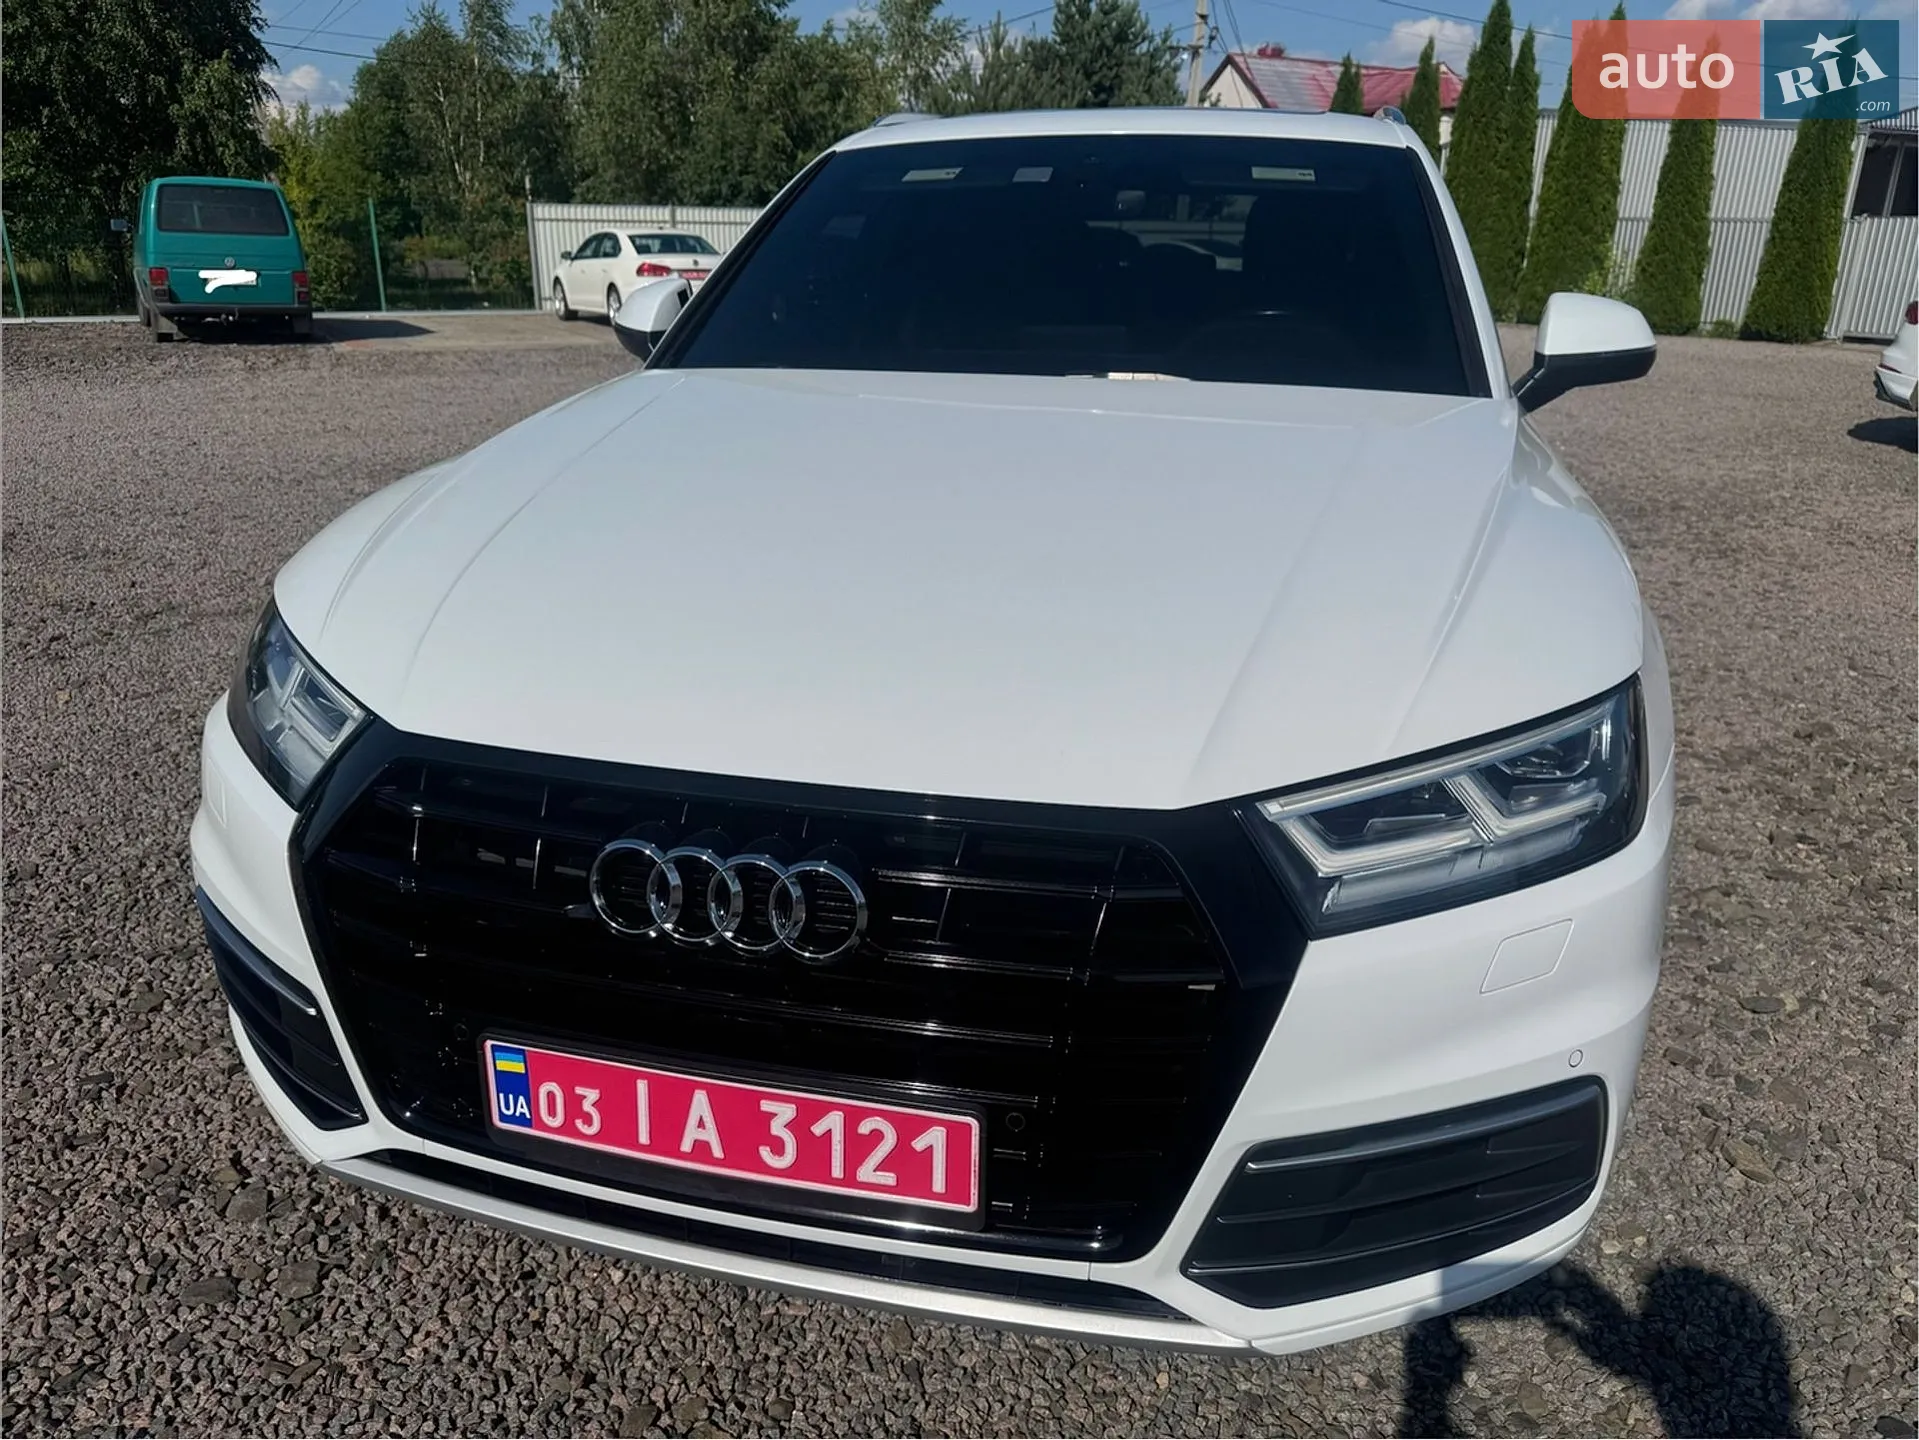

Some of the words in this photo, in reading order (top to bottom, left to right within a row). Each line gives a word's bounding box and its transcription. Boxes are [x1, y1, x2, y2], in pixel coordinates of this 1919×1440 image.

[498, 1092, 532, 1119] UA
[537, 1081, 602, 1136] 03
[758, 1099, 948, 1194] 3121
